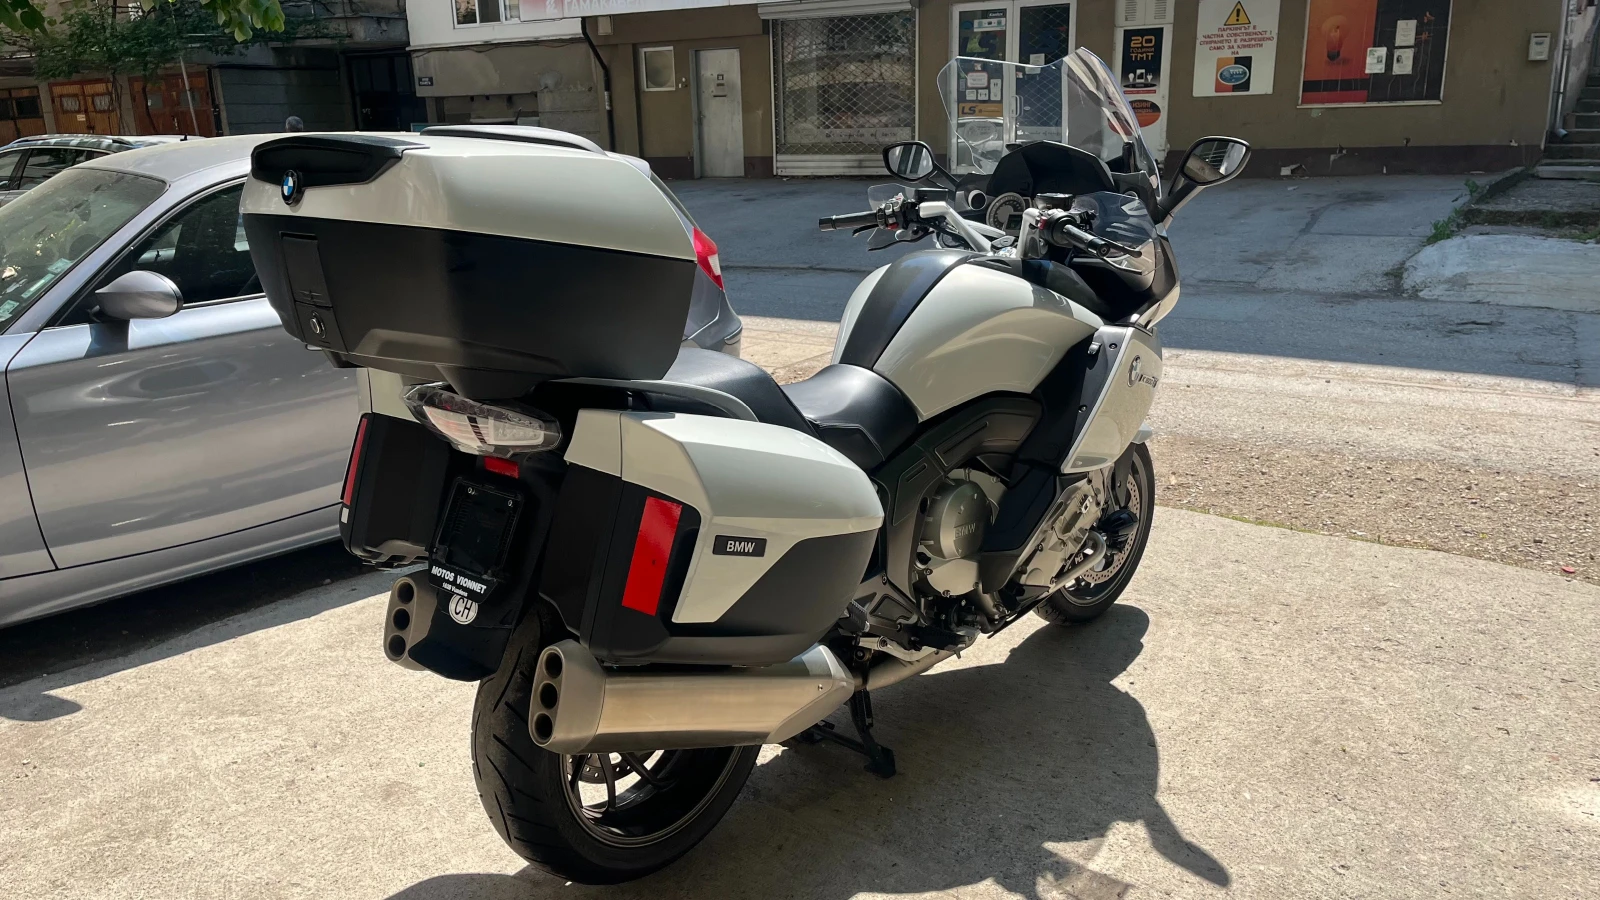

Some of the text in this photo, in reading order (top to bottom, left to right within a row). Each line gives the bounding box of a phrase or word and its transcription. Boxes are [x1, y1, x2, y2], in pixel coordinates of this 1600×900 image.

[1218, 25, 1250, 33] ПАРКИНГЪТ
[1226, 30, 1267, 38] СОБСТВЕНОСТ
[1130, 36, 1155, 47] 20
[1199, 38, 1232, 46] СПИРАНЕТО
[954, 522, 976, 540] BMW
[726, 540, 756, 553] BMW
[431, 566, 487, 593] MOTOS VIONNET
[454, 597, 474, 620] CH
